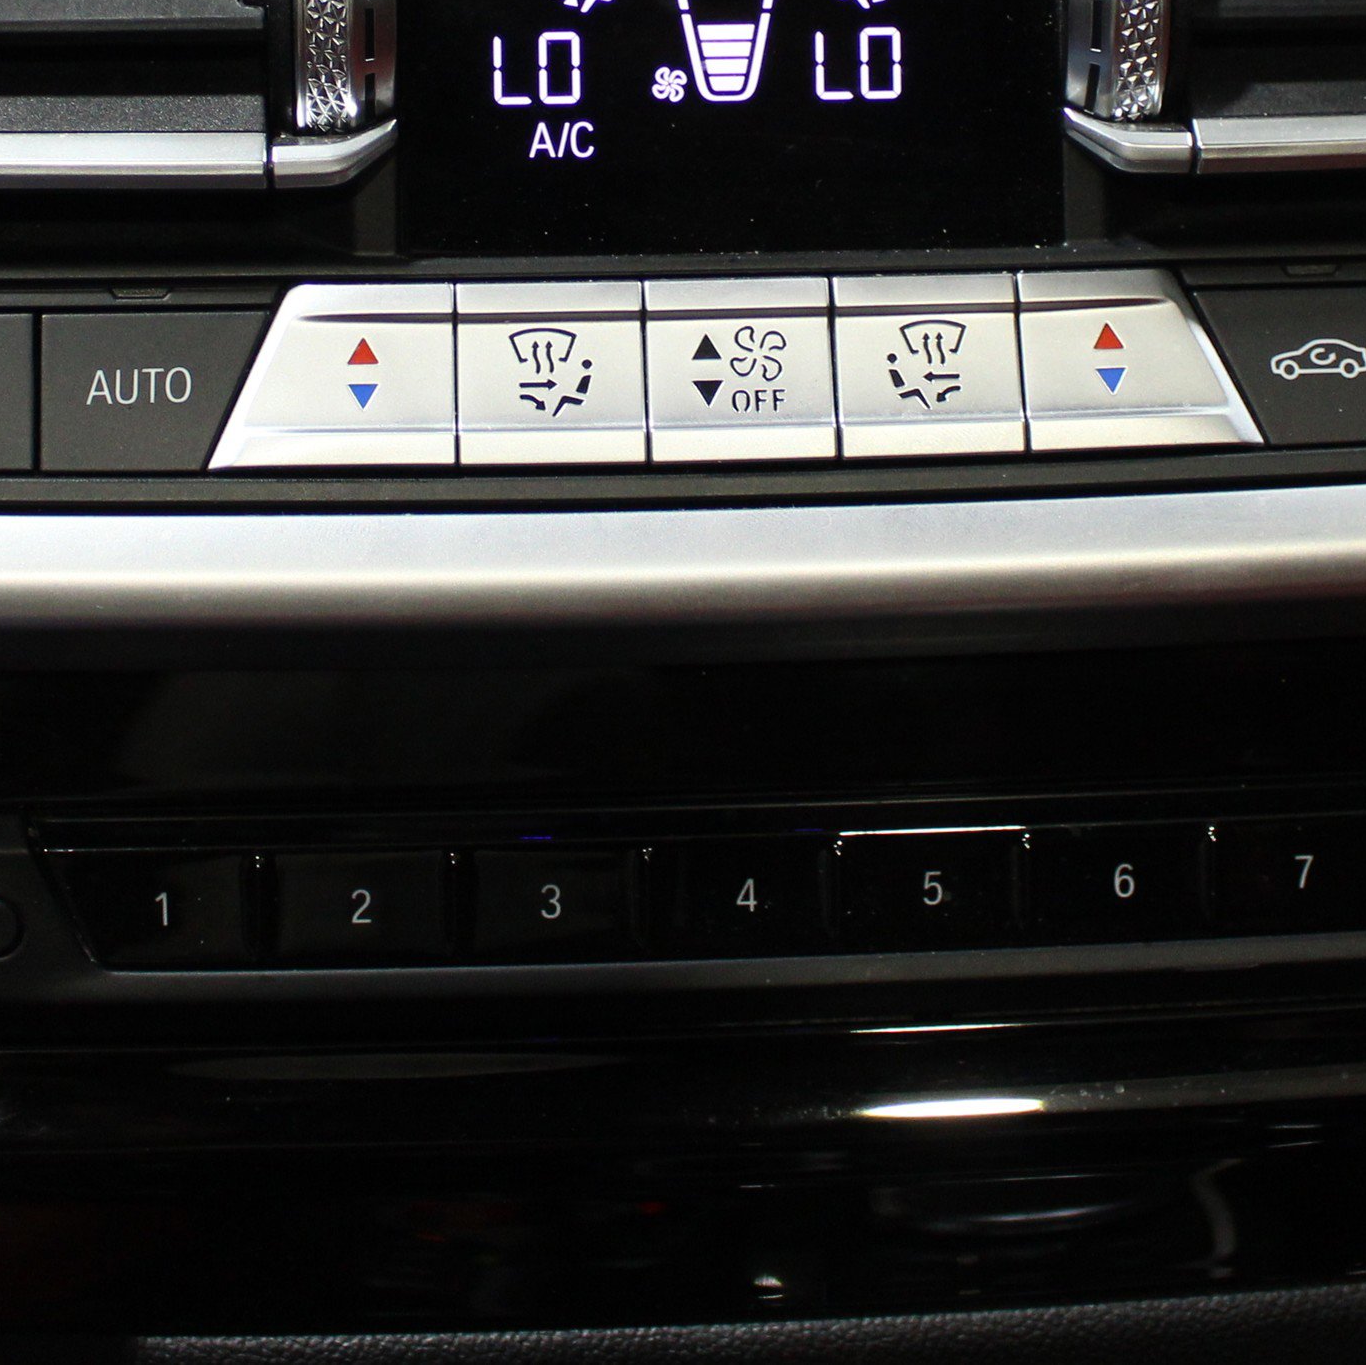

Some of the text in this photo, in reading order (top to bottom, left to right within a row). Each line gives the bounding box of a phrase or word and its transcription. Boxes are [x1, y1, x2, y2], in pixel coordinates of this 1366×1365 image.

[492, 30, 581, 106] LO
[814, 26, 902, 101] LO
[528, 120, 595, 159] A/C
[86, 366, 192, 405] AUTO
[731, 388, 786, 413] OFF
[923, 870, 943, 906] 5
[1113, 863, 1135, 898] 6
[1294, 854, 1314, 889] 7
[155, 892, 169, 927] 1
[351, 889, 372, 924] 2
[541, 884, 562, 919] 3
[736, 878, 758, 912] 4
